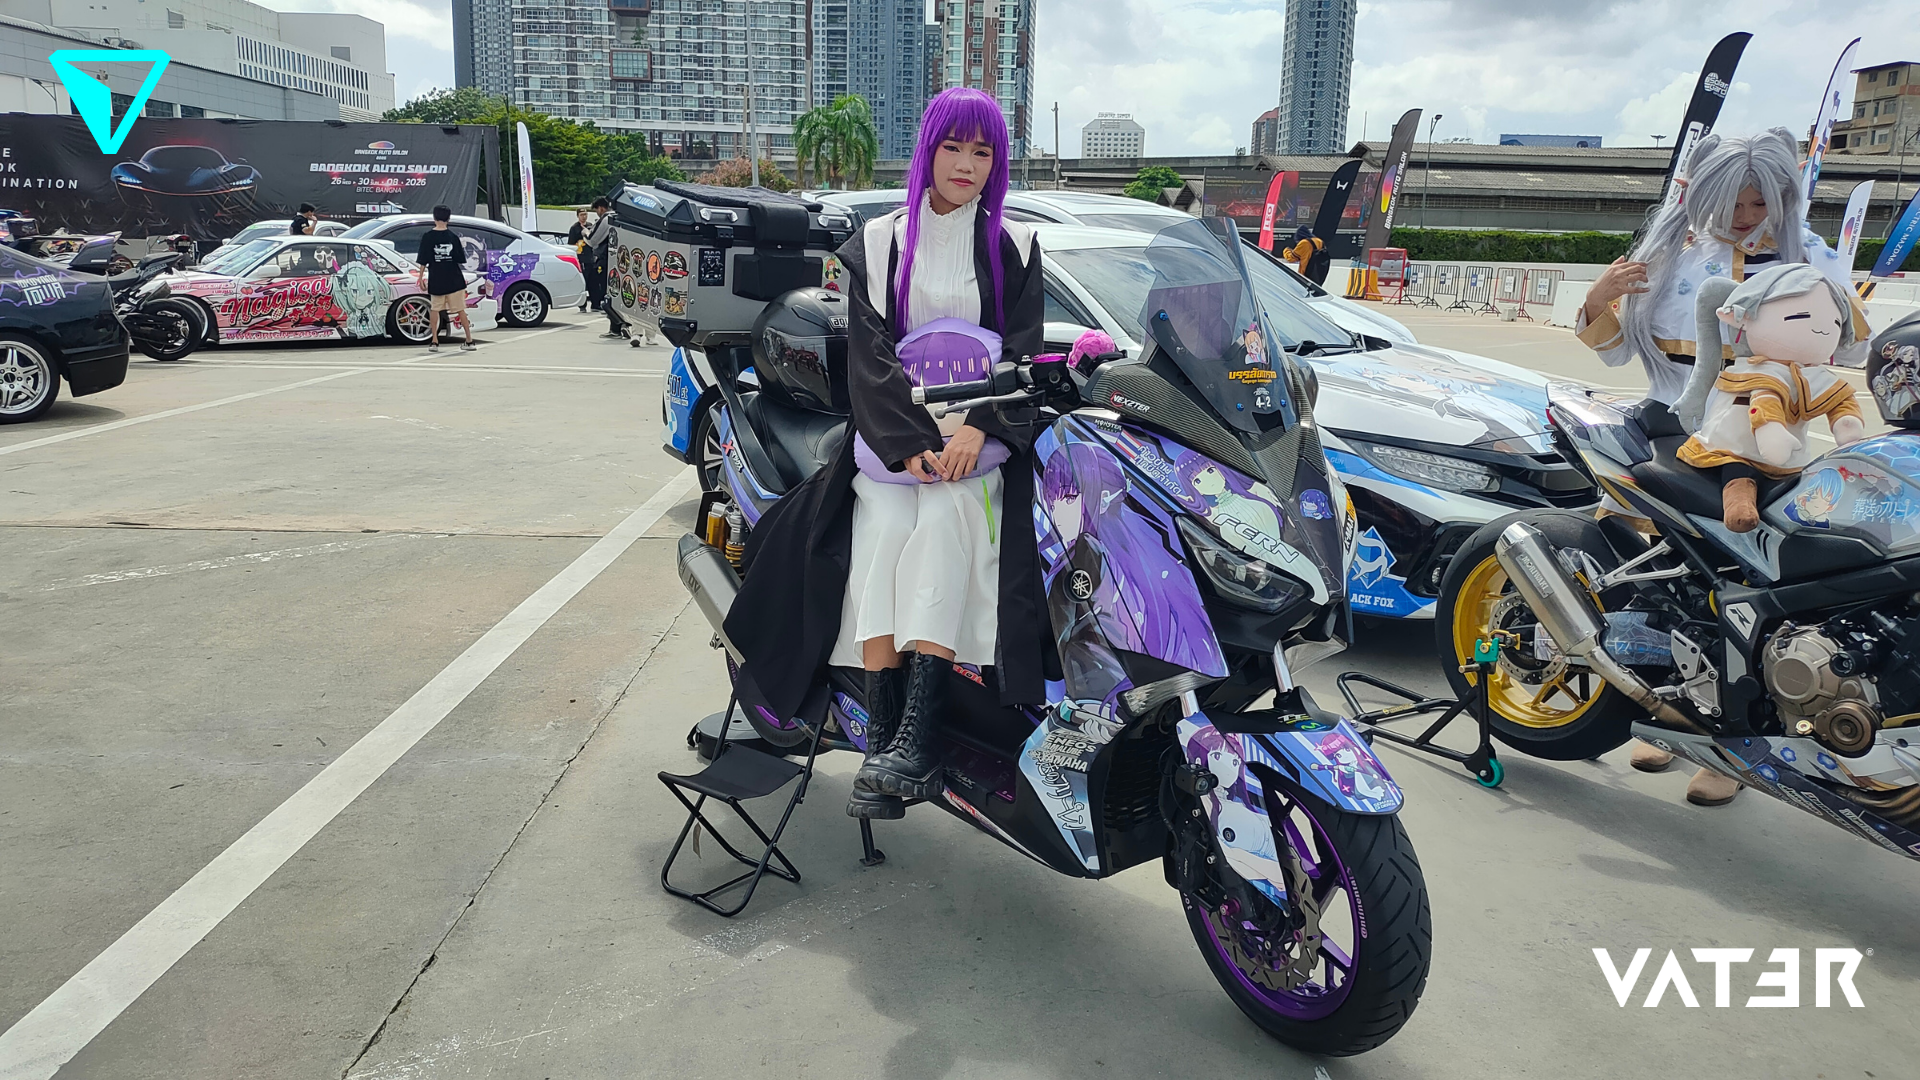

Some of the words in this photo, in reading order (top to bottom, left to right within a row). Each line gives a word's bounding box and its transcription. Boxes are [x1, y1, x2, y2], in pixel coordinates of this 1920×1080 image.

[1709, 83, 1727, 96] Gard
[1710, 78, 1729, 89] Solar
[310, 163, 370, 173] BANGKOK
[372, 163, 405, 173] AUTO
[405, 165, 448, 174] SALON
[1396, 151, 1408, 176] SALON
[2, 177, 78, 190] INATION
[330, 177, 342, 185] 26
[357, 177, 370, 186] 30
[386, 178, 399, 186] 08
[405, 178, 427, 186] 2026
[375, 186, 402, 194] BANGNA
[1391, 176, 1402, 196] AUTO
[1384, 195, 1397, 230] BANGKOK
[1885, 233, 1910, 266] MAZDA6e
[220, 276, 332, 326] Nagisa
[1112, 392, 1150, 413] NEXZTER
[1213, 513, 1300, 563] FERN
[1520, 554, 1549, 592] MORIWAKI
[1374, 596, 1395, 608] FOX
[1047, 734, 1097, 753] ENEOS
[1043, 751, 1088, 773] YAMAHA
